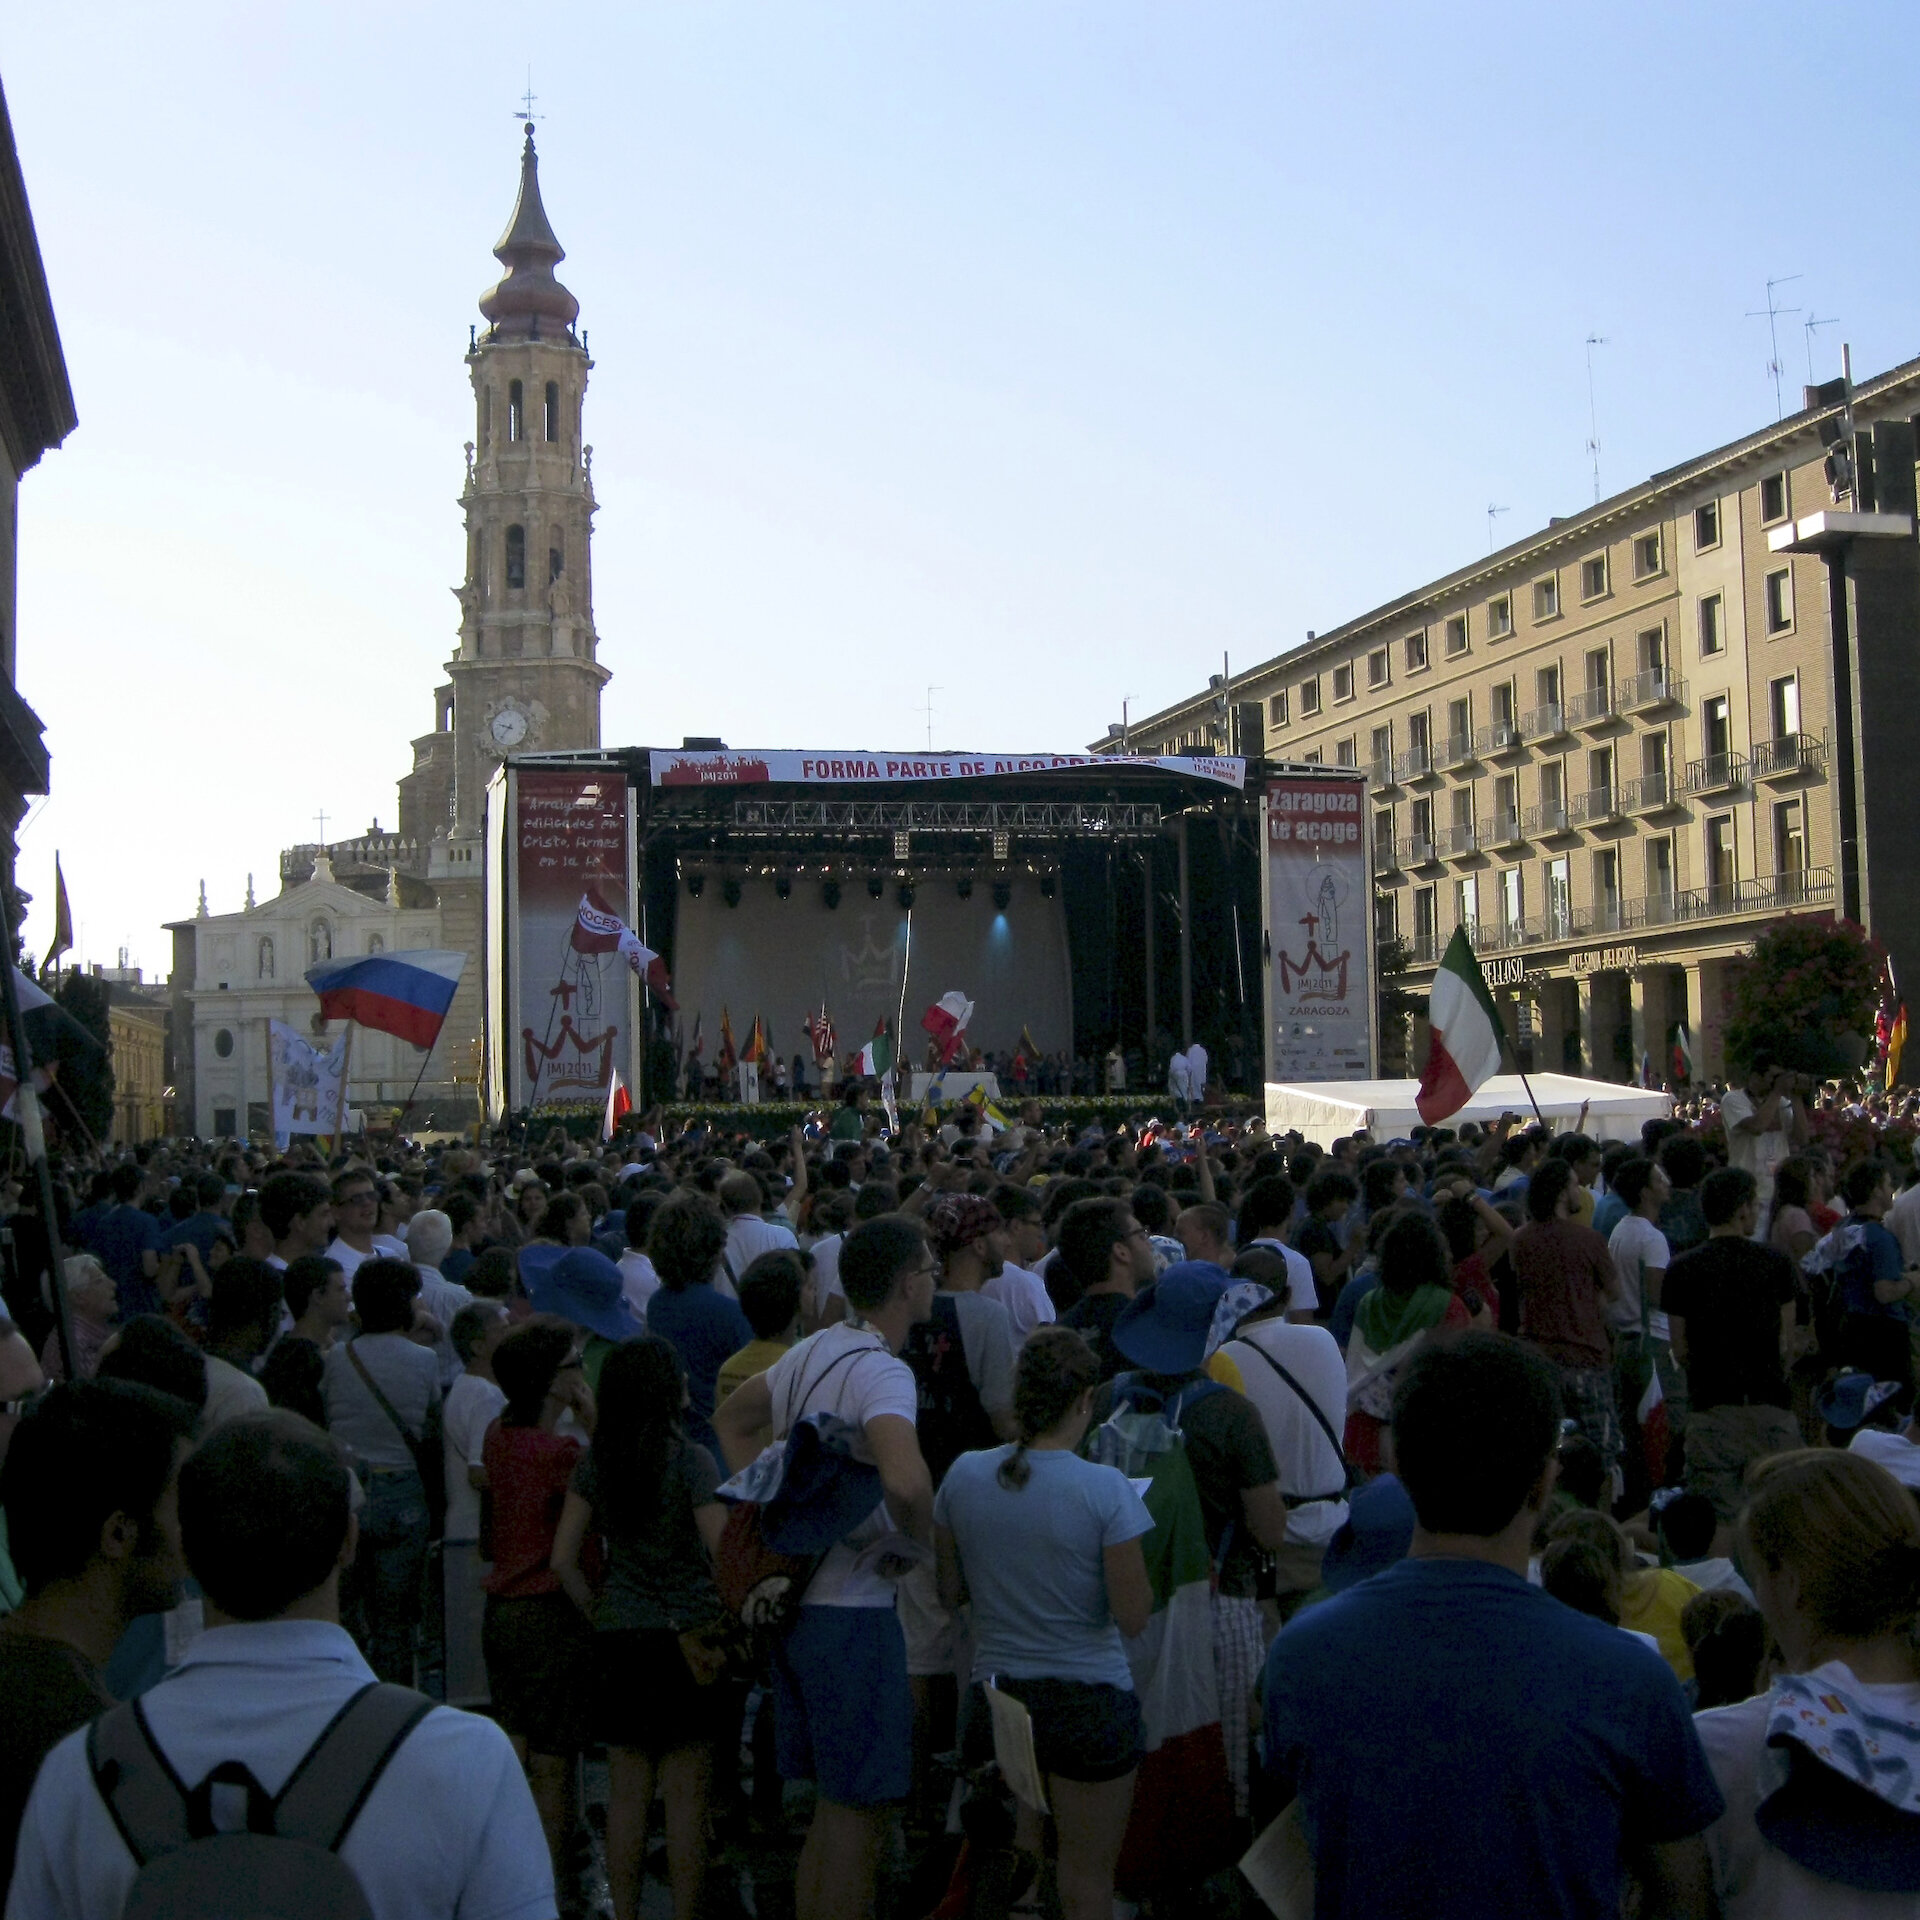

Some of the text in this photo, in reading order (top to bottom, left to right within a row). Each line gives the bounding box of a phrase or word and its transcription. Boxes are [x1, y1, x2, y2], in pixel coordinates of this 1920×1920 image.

[802, 759, 880, 779] FORMA
[886, 760, 953, 777] PARTE
[959, 761, 985, 776] DE
[1269, 788, 1358, 814] Zaragoza
[1271, 818, 1358, 844] te acoge
[522, 835, 570, 849] Cristo,
[1289, 1006, 1350, 1016] ZARAGOZA
